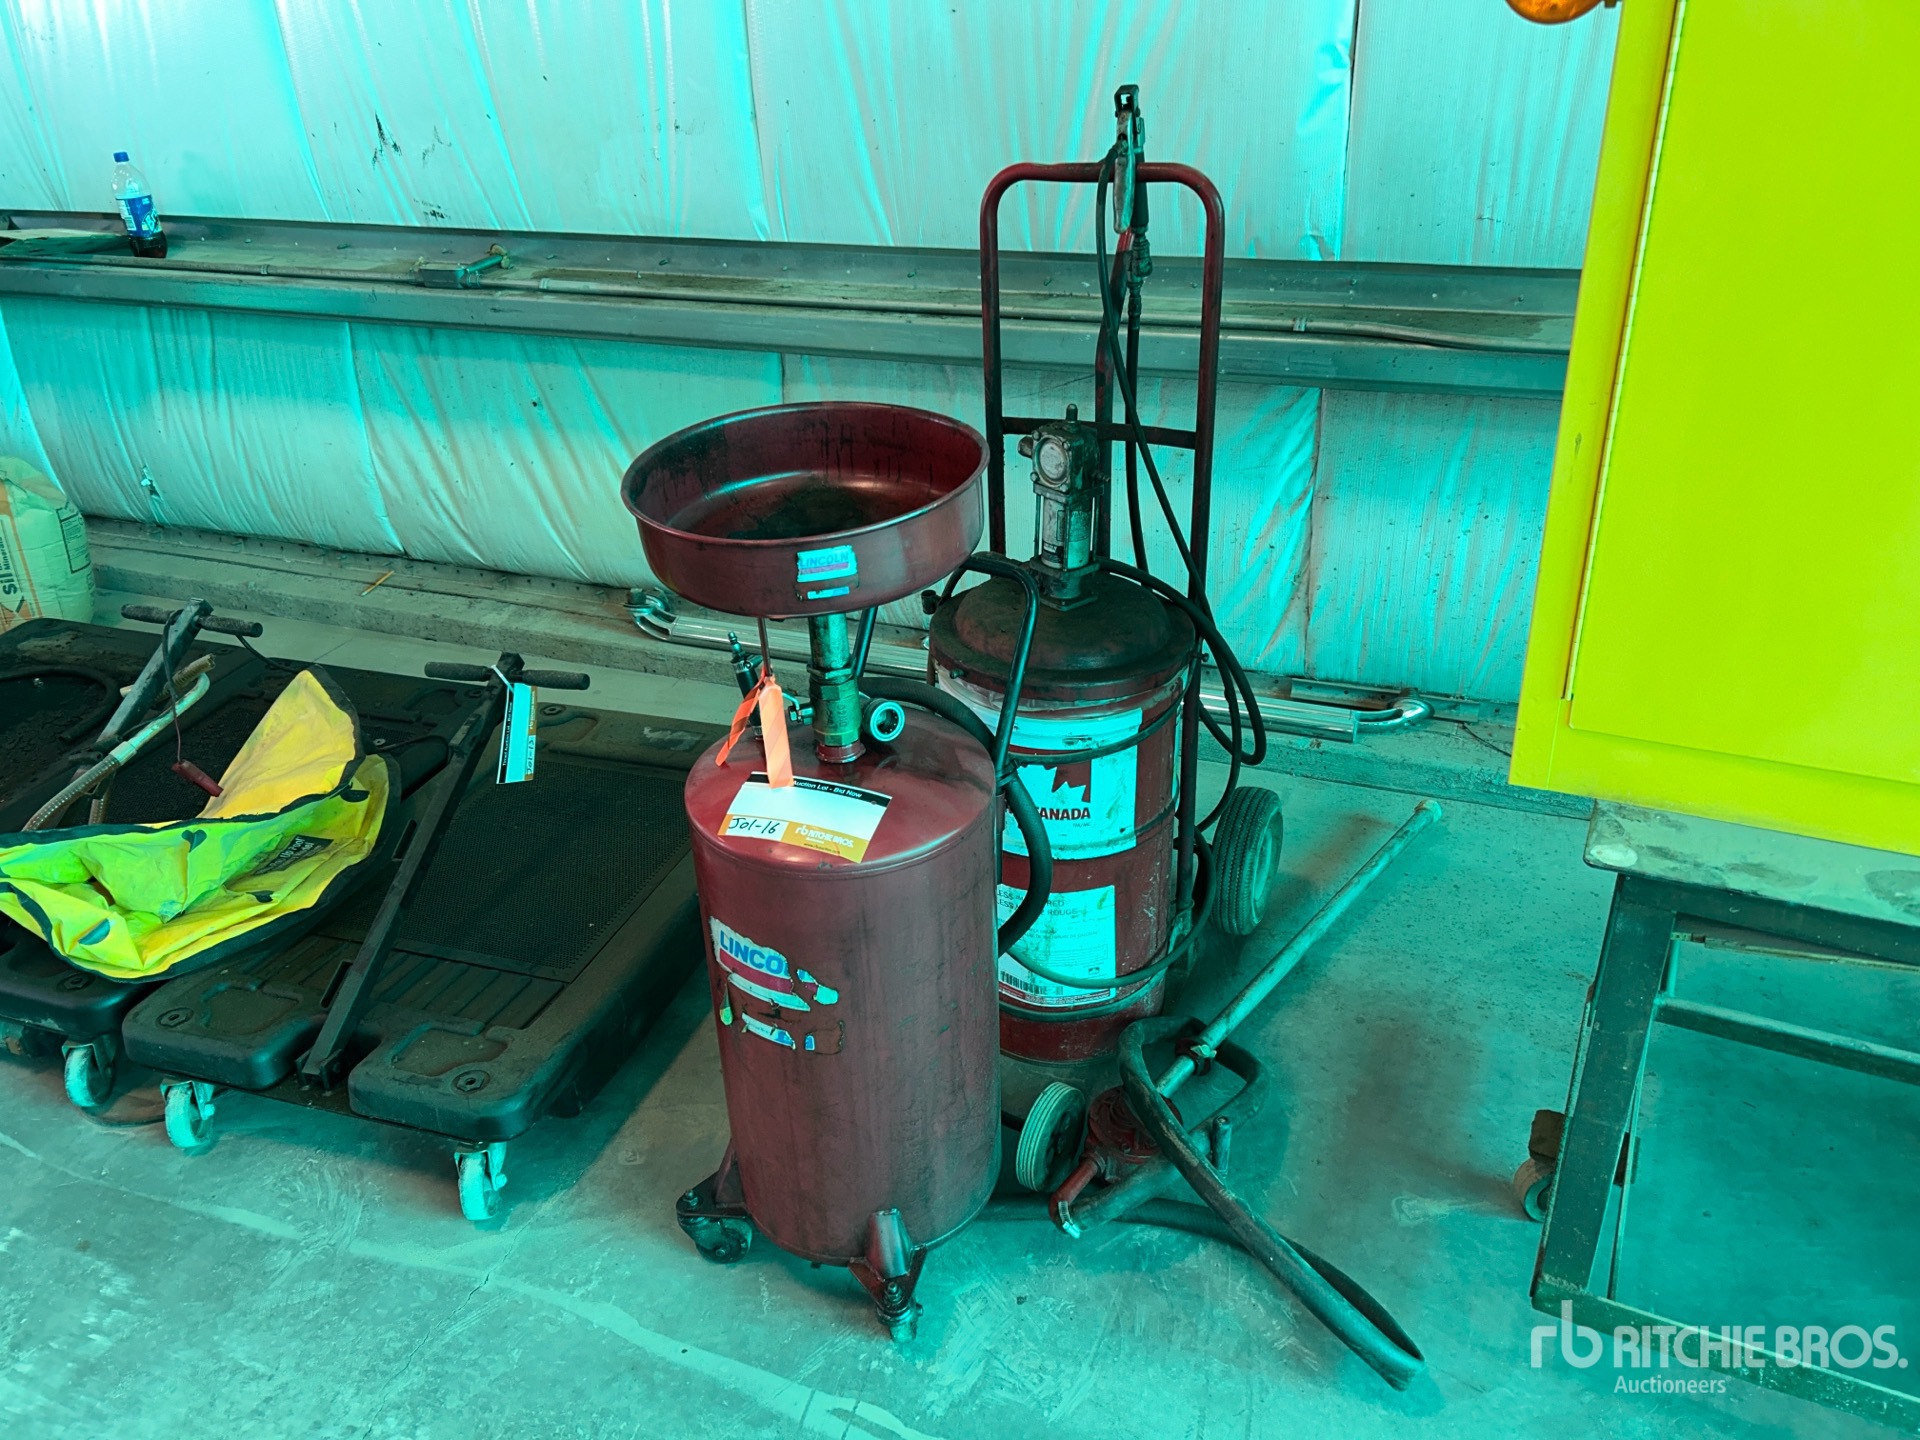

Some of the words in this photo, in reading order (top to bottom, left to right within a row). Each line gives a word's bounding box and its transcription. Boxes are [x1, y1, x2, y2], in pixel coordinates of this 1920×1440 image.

[800, 552, 848, 567] LINCOLN
[846, 789, 863, 798] Now
[1036, 807, 1091, 820] ANADA
[997, 889, 1013, 900] ESS
[720, 930, 789, 976] LINCO
